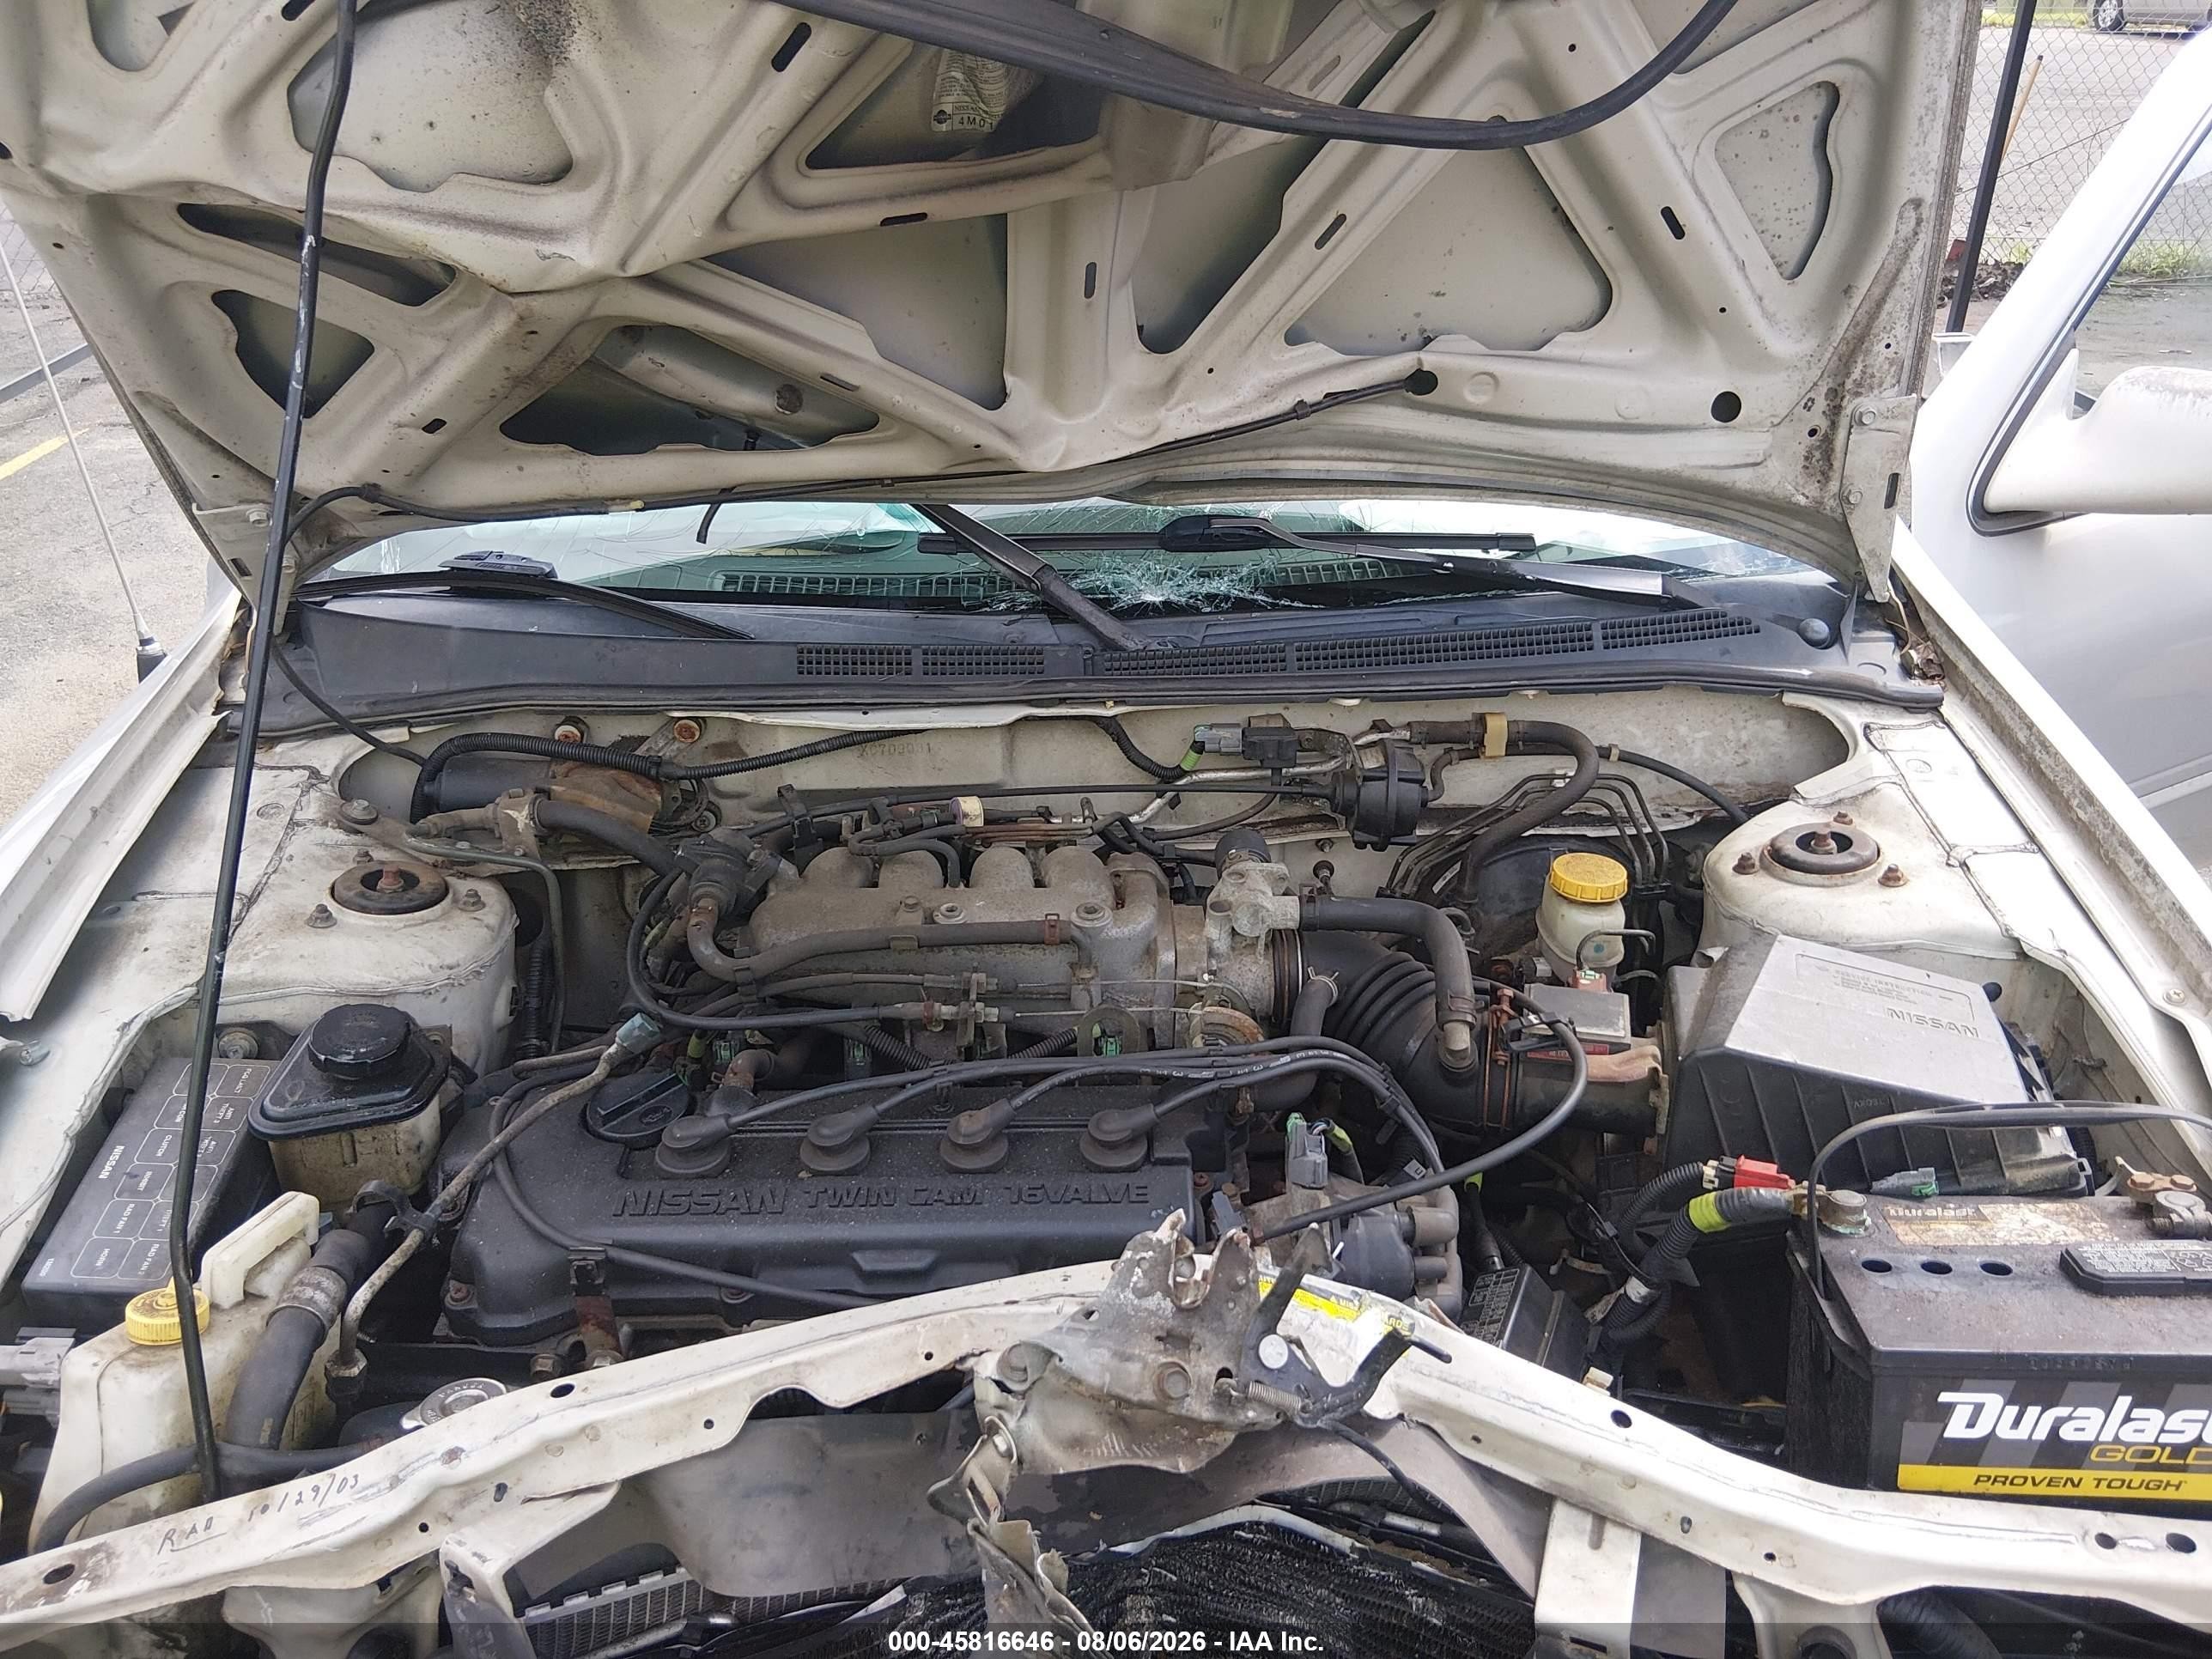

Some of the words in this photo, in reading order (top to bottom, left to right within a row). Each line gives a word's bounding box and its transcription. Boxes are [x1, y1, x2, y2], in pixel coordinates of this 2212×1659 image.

[1886, 1006, 1980, 1038] NISSAN
[155, 1134, 173, 1157] CLUTCH
[97, 1145, 125, 1180] NISSAN
[124, 1203, 136, 1218] RAD
[612, 1187, 788, 1218] NISSAN
[802, 1186, 898, 1210] TWIN
[908, 1186, 988, 1207] CAM
[95, 1248, 111, 1267] HORN
[148, 1243, 160, 1258] RAD
[143, 1256, 153, 1271] FAN
[1973, 1474, 2083, 1489] PROVEN
